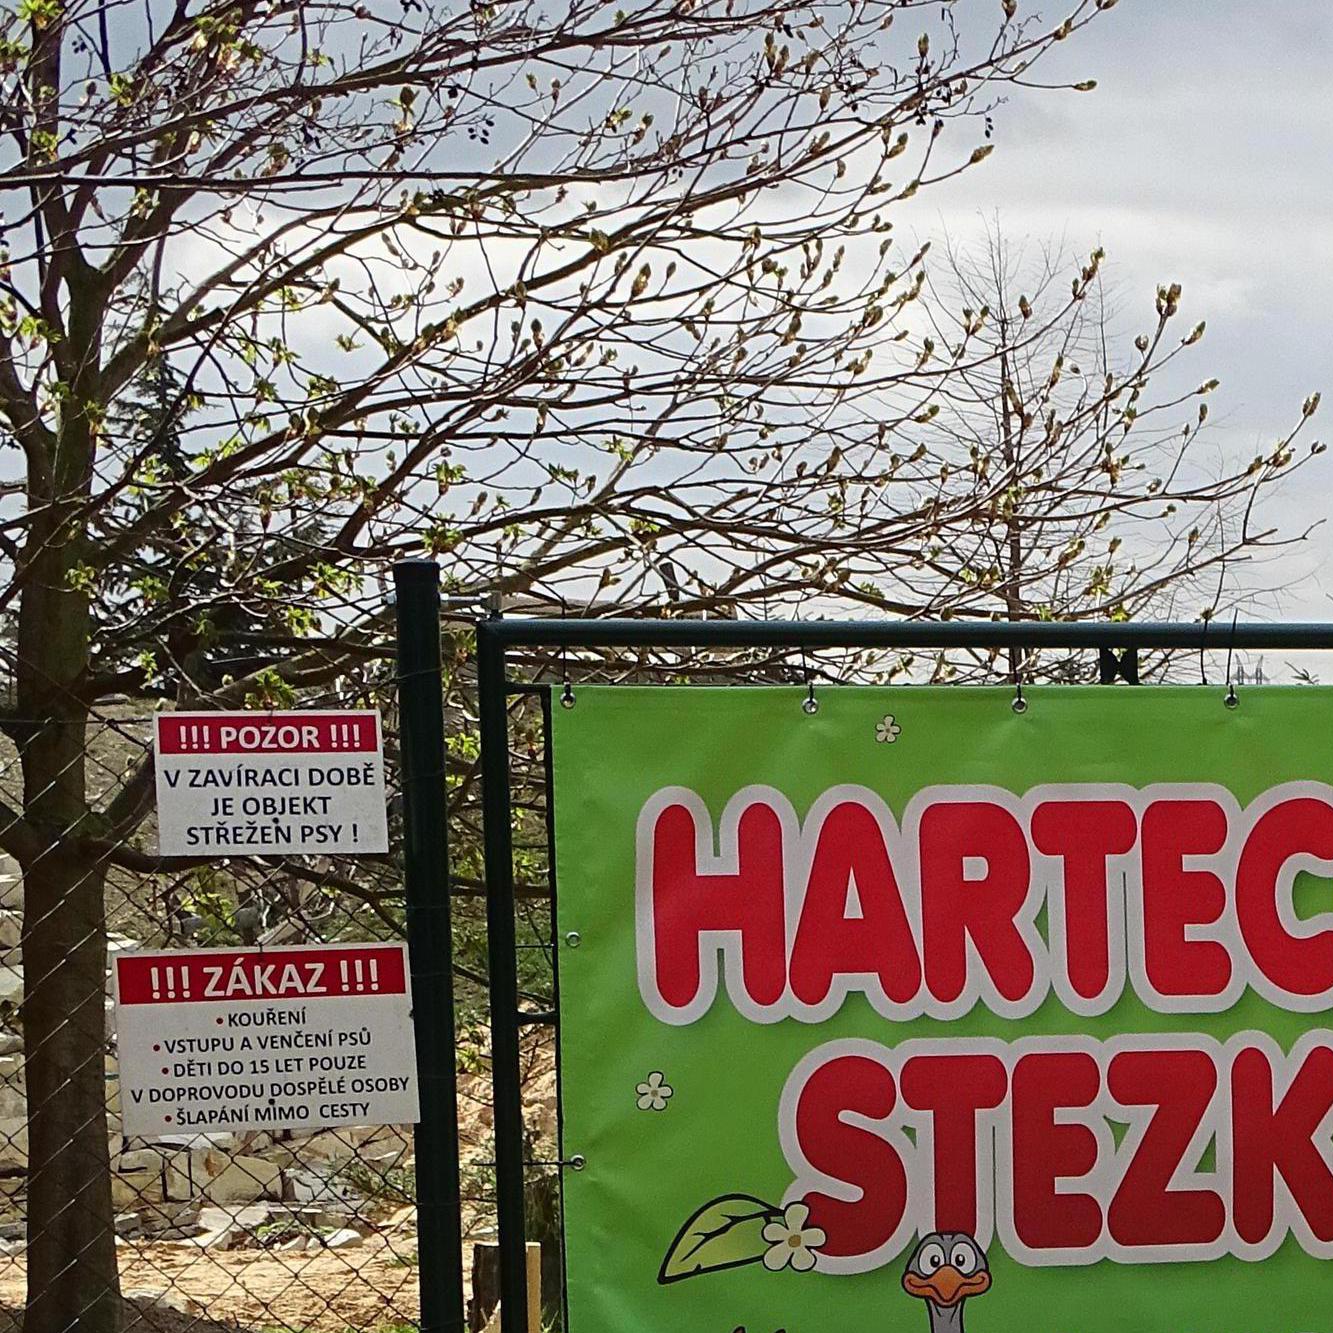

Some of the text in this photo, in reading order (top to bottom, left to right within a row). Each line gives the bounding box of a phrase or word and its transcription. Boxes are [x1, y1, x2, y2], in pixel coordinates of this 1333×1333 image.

[180, 724, 360, 749] !!! POZOR !!!
[164, 762, 375, 788] V ZAVÍRACI DOBĚ
[210, 796, 331, 816] JE OBJEKT
[186, 820, 358, 845] STŘEŽEN PSY !
[150, 958, 378, 999] !!! ZÁKAZ !!!
[228, 1006, 305, 1027] KOUŘENÍ
[164, 1026, 370, 1054] VSTUPU A VENČENÍ PSŮ
[174, 1055, 366, 1078] DĚTI DO 15 LET POUZE
[130, 1075, 409, 1104] V DOPROVODU DOSPĚLÉ OSOBY
[176, 1102, 369, 1126] ŠLAPÁNÍ MIMO CESTY
